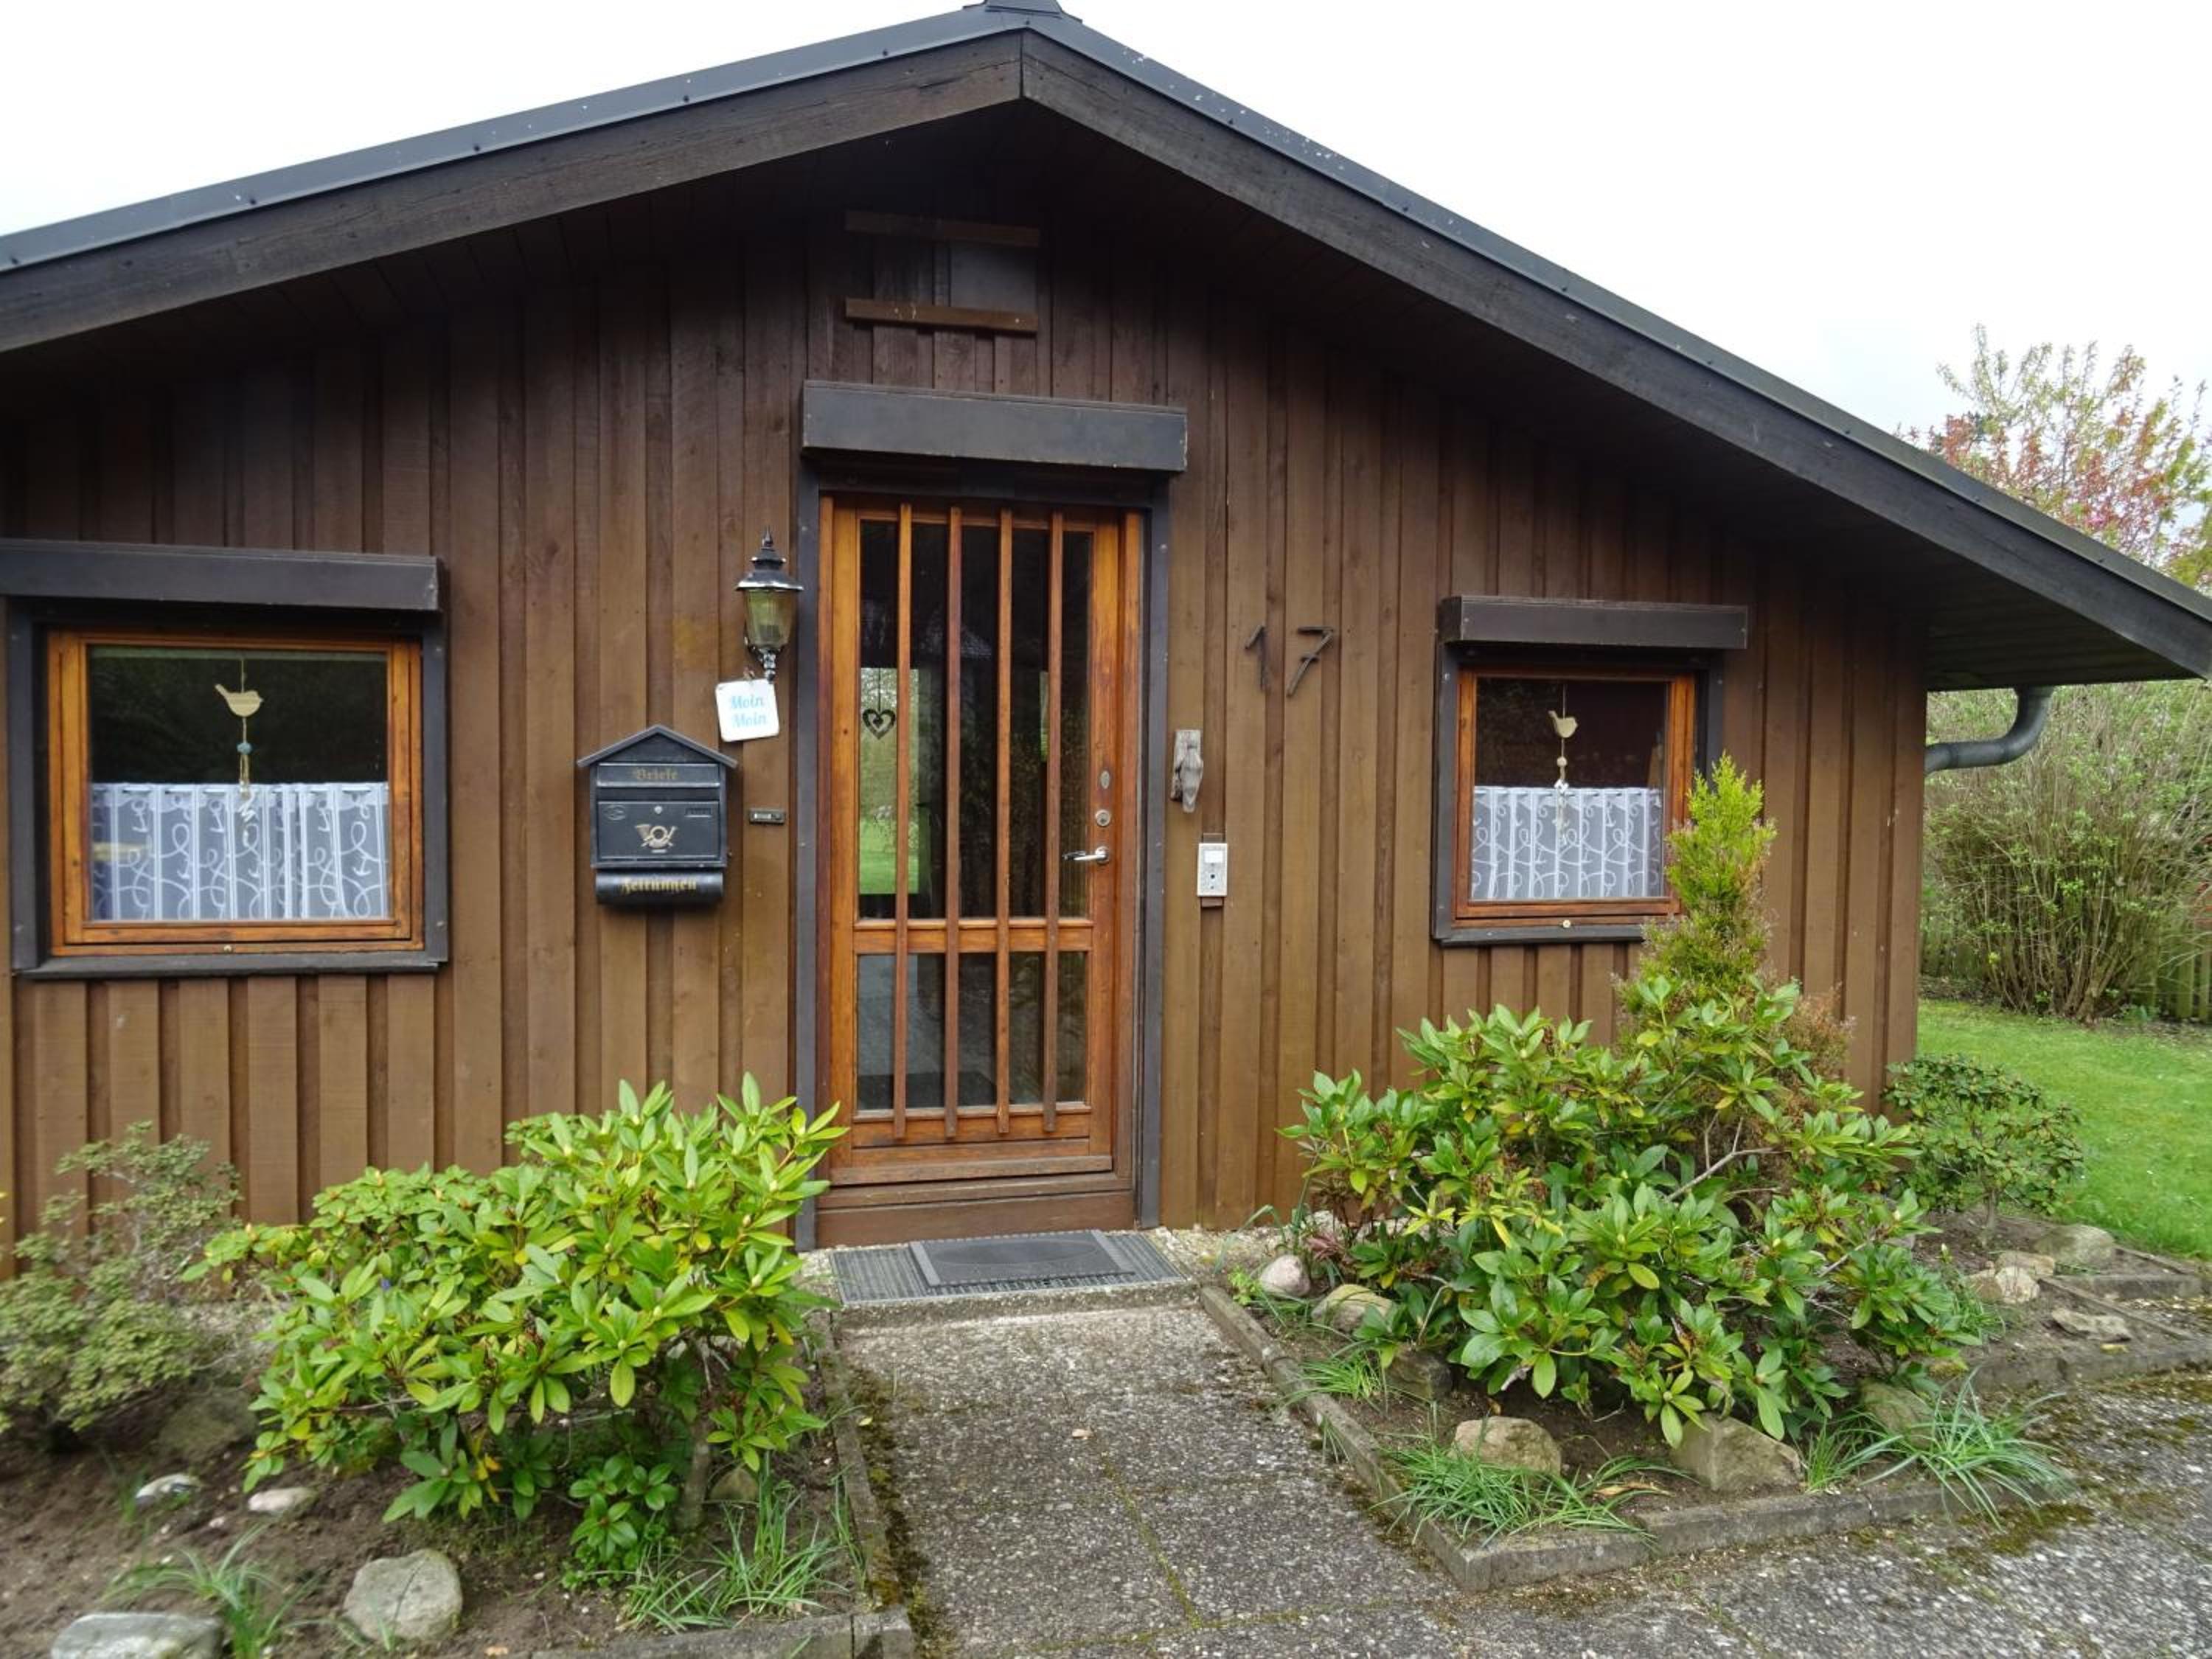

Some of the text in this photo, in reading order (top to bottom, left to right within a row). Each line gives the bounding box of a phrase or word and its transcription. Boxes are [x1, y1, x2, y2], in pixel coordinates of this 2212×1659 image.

[1245, 625, 1334, 697] 17
[730, 694, 765, 708] Moin
[731, 712, 767, 727] Moin
